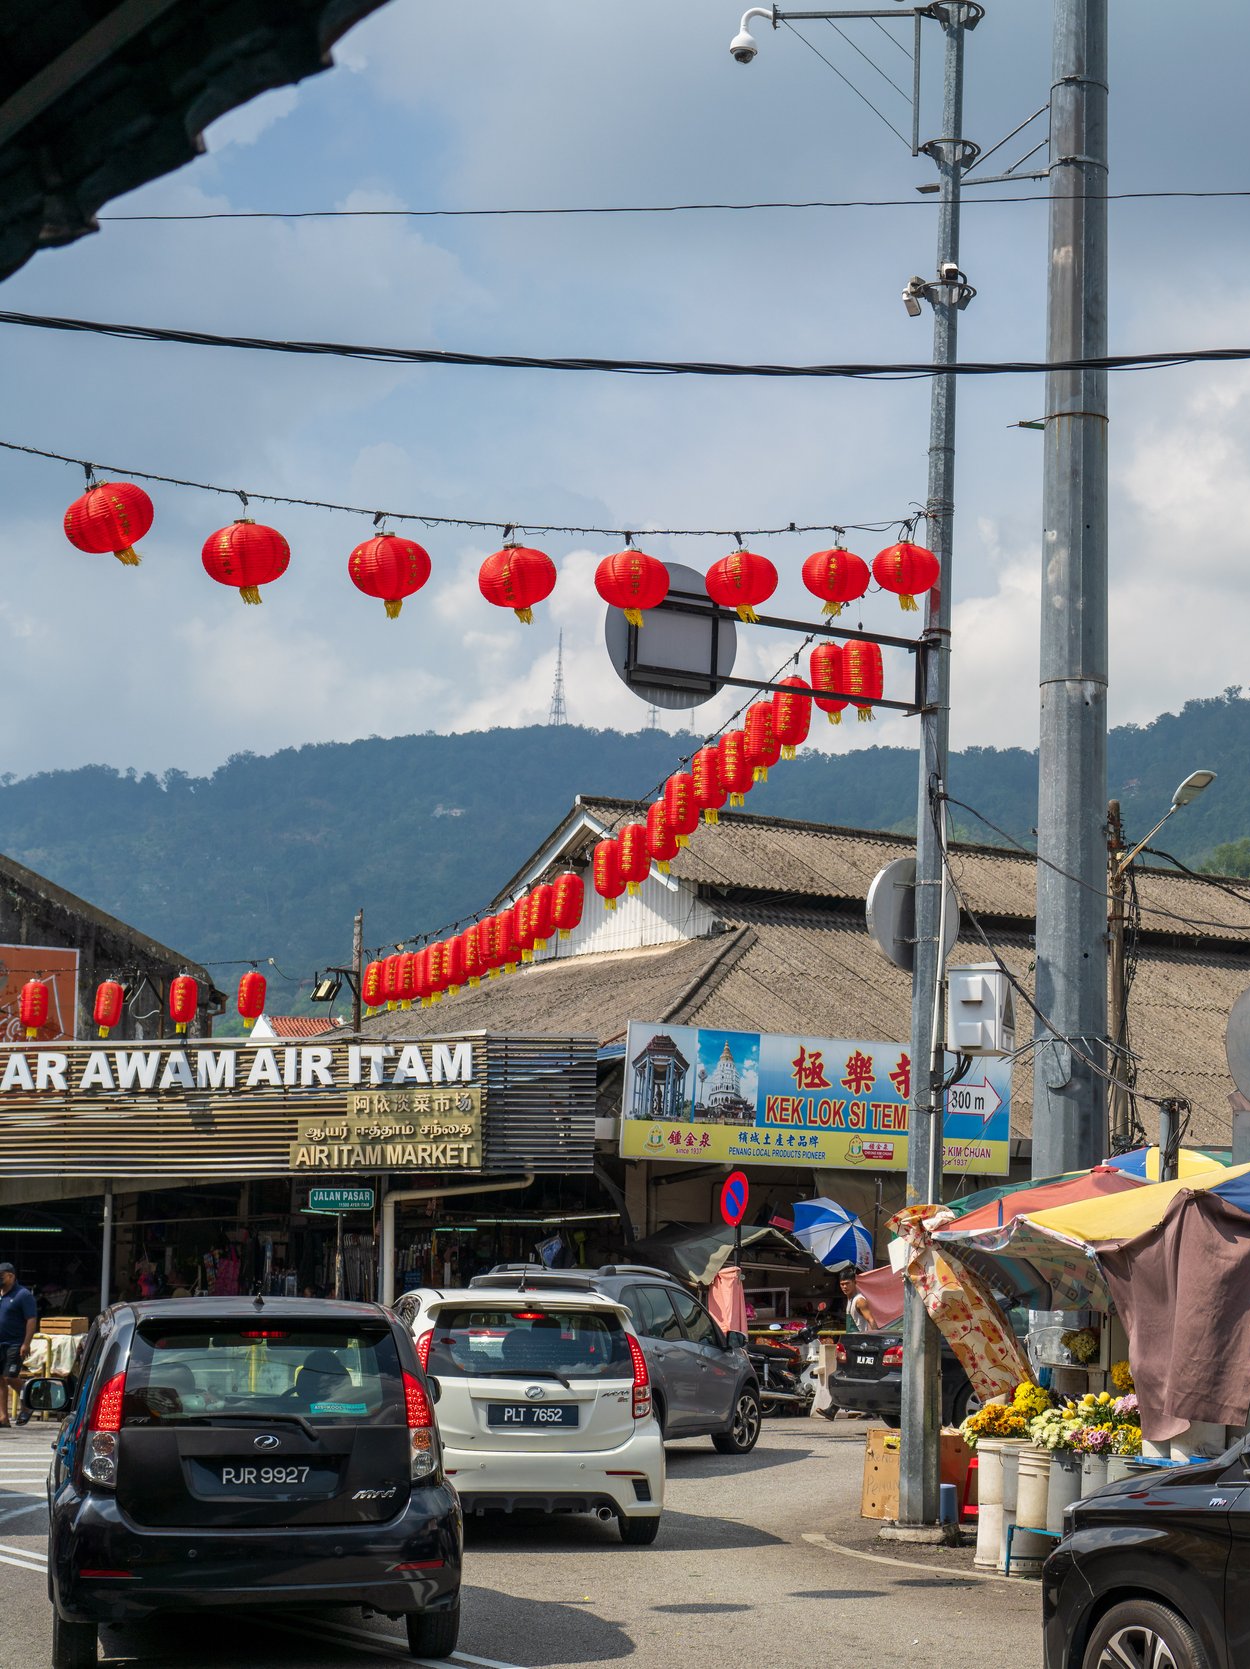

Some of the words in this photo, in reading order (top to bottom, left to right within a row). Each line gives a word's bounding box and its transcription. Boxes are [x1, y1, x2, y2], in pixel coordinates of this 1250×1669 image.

[79, 1050, 236, 1089] AWAM
[246, 1047, 335, 1086] AIR
[348, 1043, 472, 1083] ITAM
[354, 1093, 472, 1114] 阿依淡菜市场
[951, 1091, 970, 1109] 300
[974, 1095, 985, 1110] m
[766, 1096, 804, 1124] KEK
[808, 1099, 845, 1127] LOK
[849, 1101, 866, 1128] SI
[296, 1145, 330, 1166] AIR
[334, 1145, 383, 1166] ITAM
[387, 1144, 472, 1165] MARKET
[729, 1147, 751, 1156] PENANG
[753, 1148, 770, 1157] LOCAL
[772, 1149, 801, 1159] PRODUCTS
[802, 1151, 826, 1160] PIONEER
[948, 1146, 962, 1157] KIM
[964, 1147, 991, 1158] CHUAN
[313, 1191, 340, 1201] JALAN
[342, 1191, 370, 1201] PASAR
[504, 1408, 526, 1422] PLT
[532, 1408, 563, 1422] 7652
[222, 1467, 257, 1485] PJR
[261, 1466, 310, 1484] 9927
